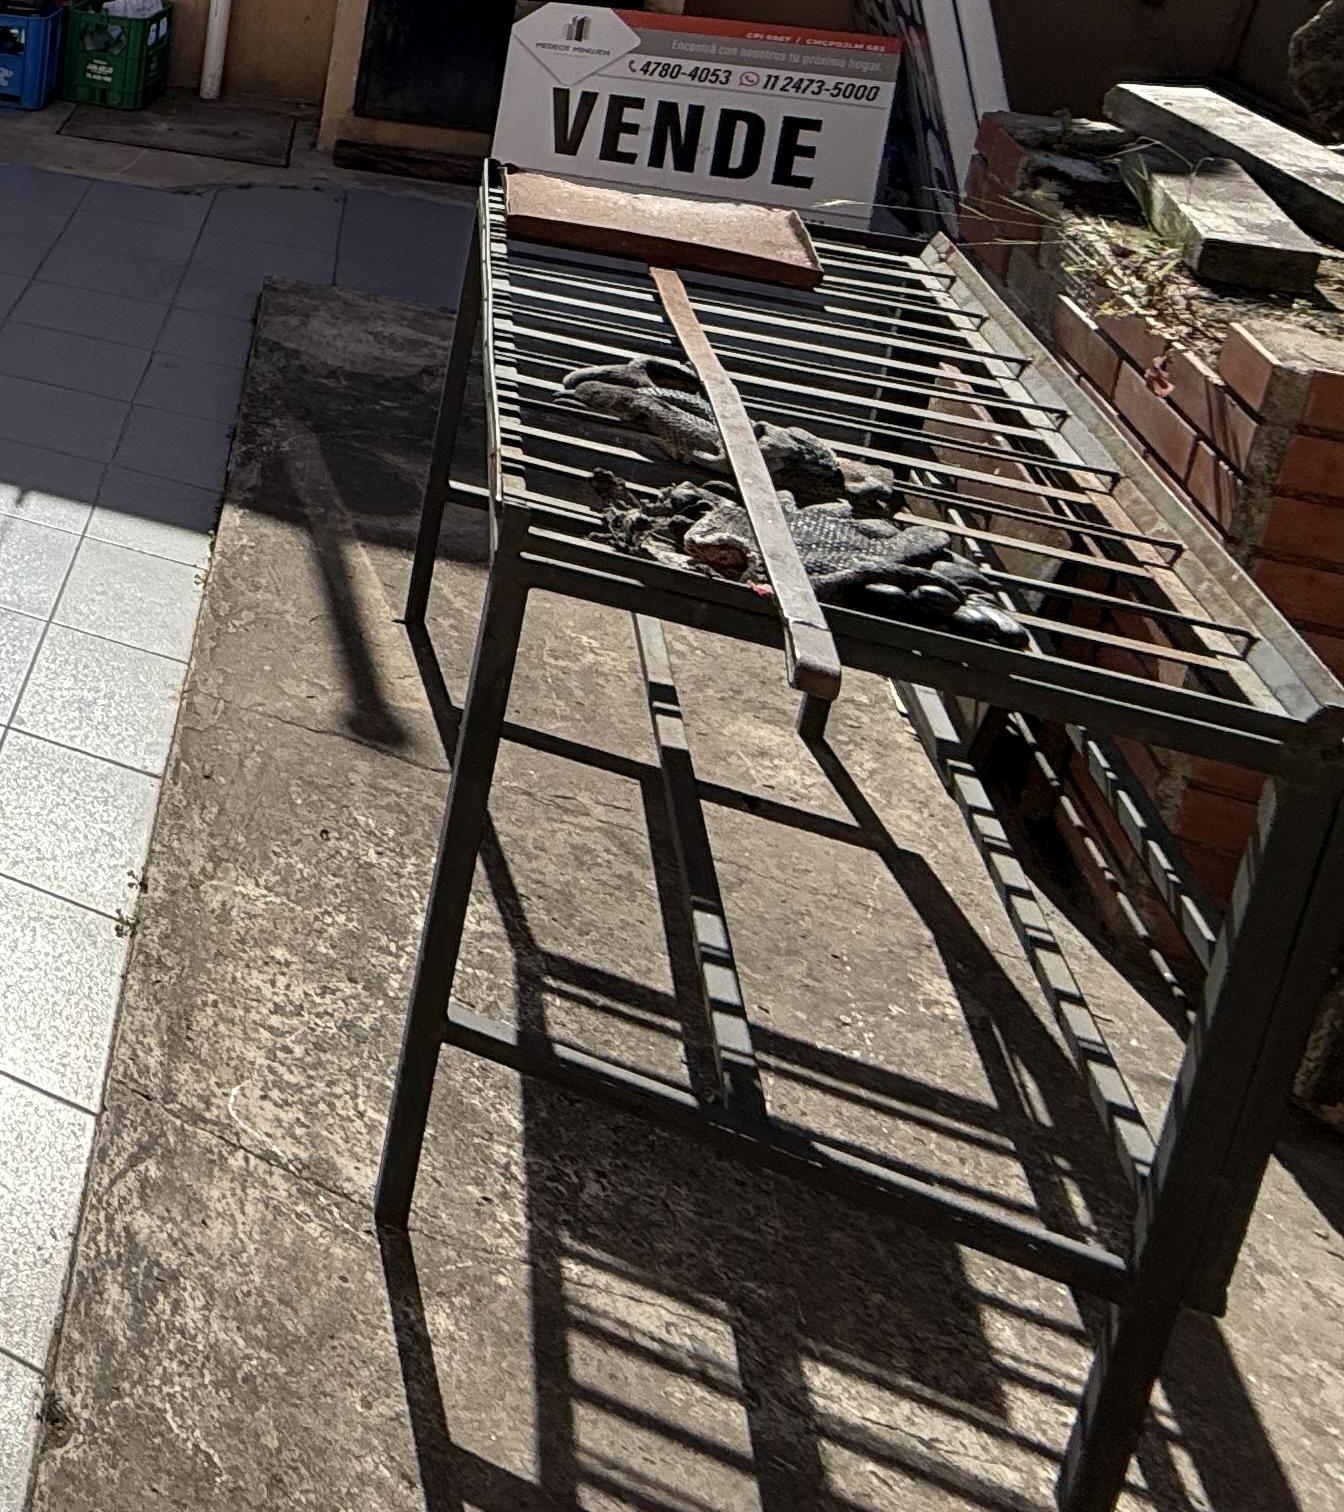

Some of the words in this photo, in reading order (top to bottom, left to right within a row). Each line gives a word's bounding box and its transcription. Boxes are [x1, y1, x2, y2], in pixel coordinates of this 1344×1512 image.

[718, 47, 738, 56] con
[740, 48, 787, 61] nosotros
[640, 60, 732, 85] 4780-4053
[552, 87, 823, 189] VENDE
